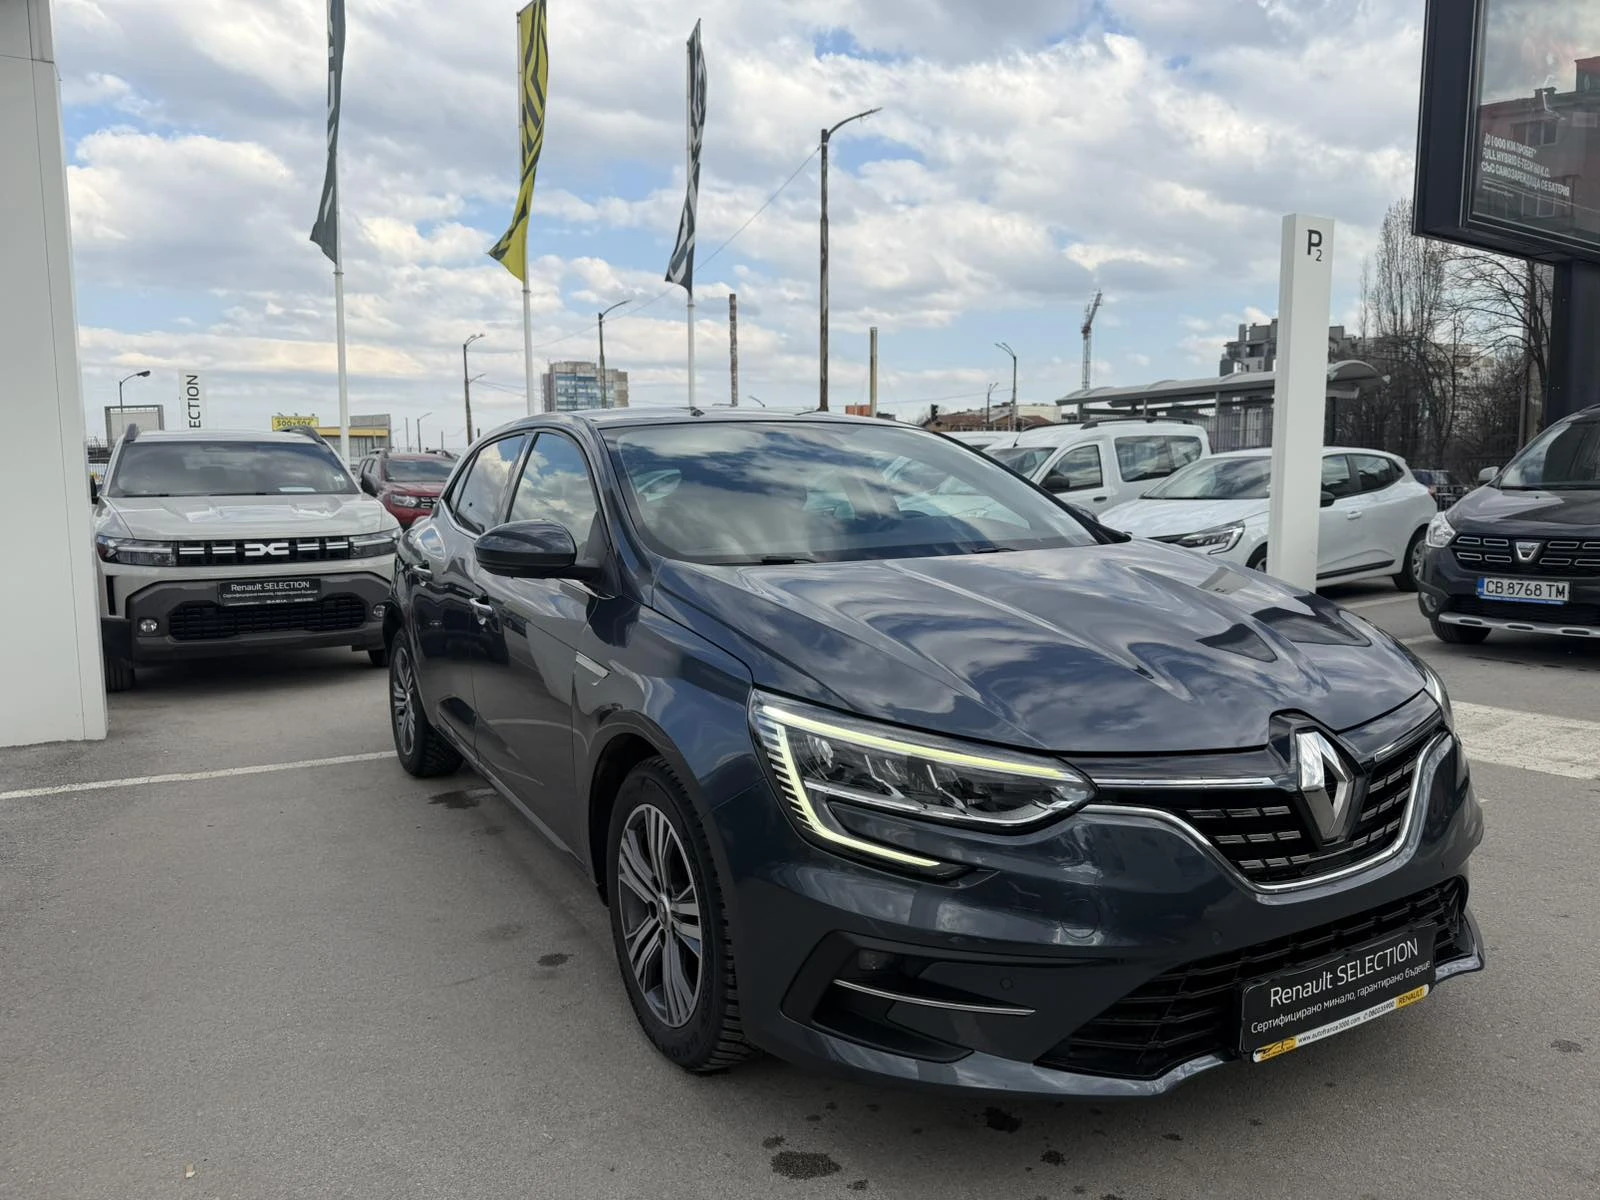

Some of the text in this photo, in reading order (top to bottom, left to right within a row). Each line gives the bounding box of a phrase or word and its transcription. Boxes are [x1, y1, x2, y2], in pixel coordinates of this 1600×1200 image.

[186, 374, 201, 428] ECTION
[231, 581, 310, 592] Renault SELECTION
[1486, 580, 1565, 598] CB 8768 TM
[1270, 938, 1418, 1008] Renault SELECTION
[1251, 960, 1431, 1034] Сертифицирано минало, гарантирано бъдеще
[1398, 987, 1424, 1006] RENAULT
